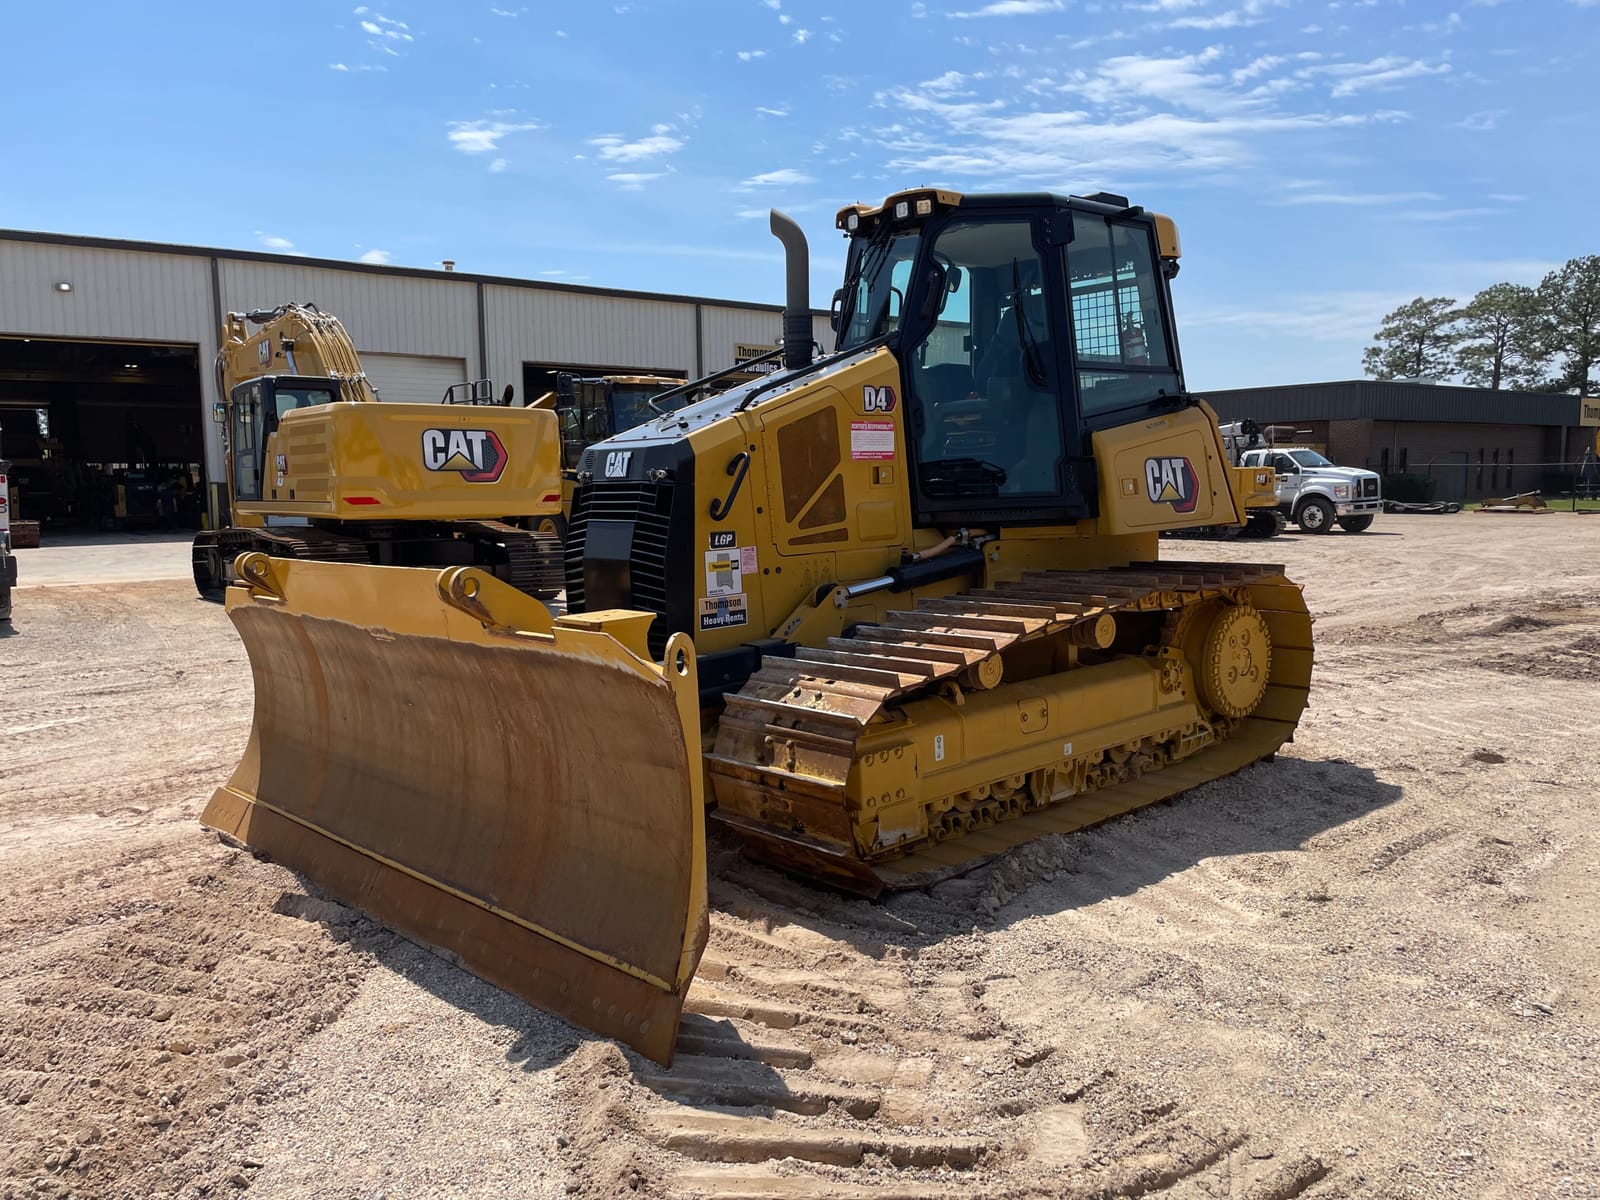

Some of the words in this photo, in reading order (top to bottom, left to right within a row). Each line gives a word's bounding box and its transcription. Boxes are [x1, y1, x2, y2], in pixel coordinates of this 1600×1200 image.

[737, 346, 776, 358] Thomp
[864, 387, 887, 411] D4
[423, 429, 488, 471] CAT
[605, 451, 632, 478] CAT
[1146, 458, 1186, 501] CAT
[714, 534, 733, 545] LGP
[704, 598, 742, 611] Thompson
[703, 615, 724, 626] Heavy
[725, 613, 744, 624] Rents
